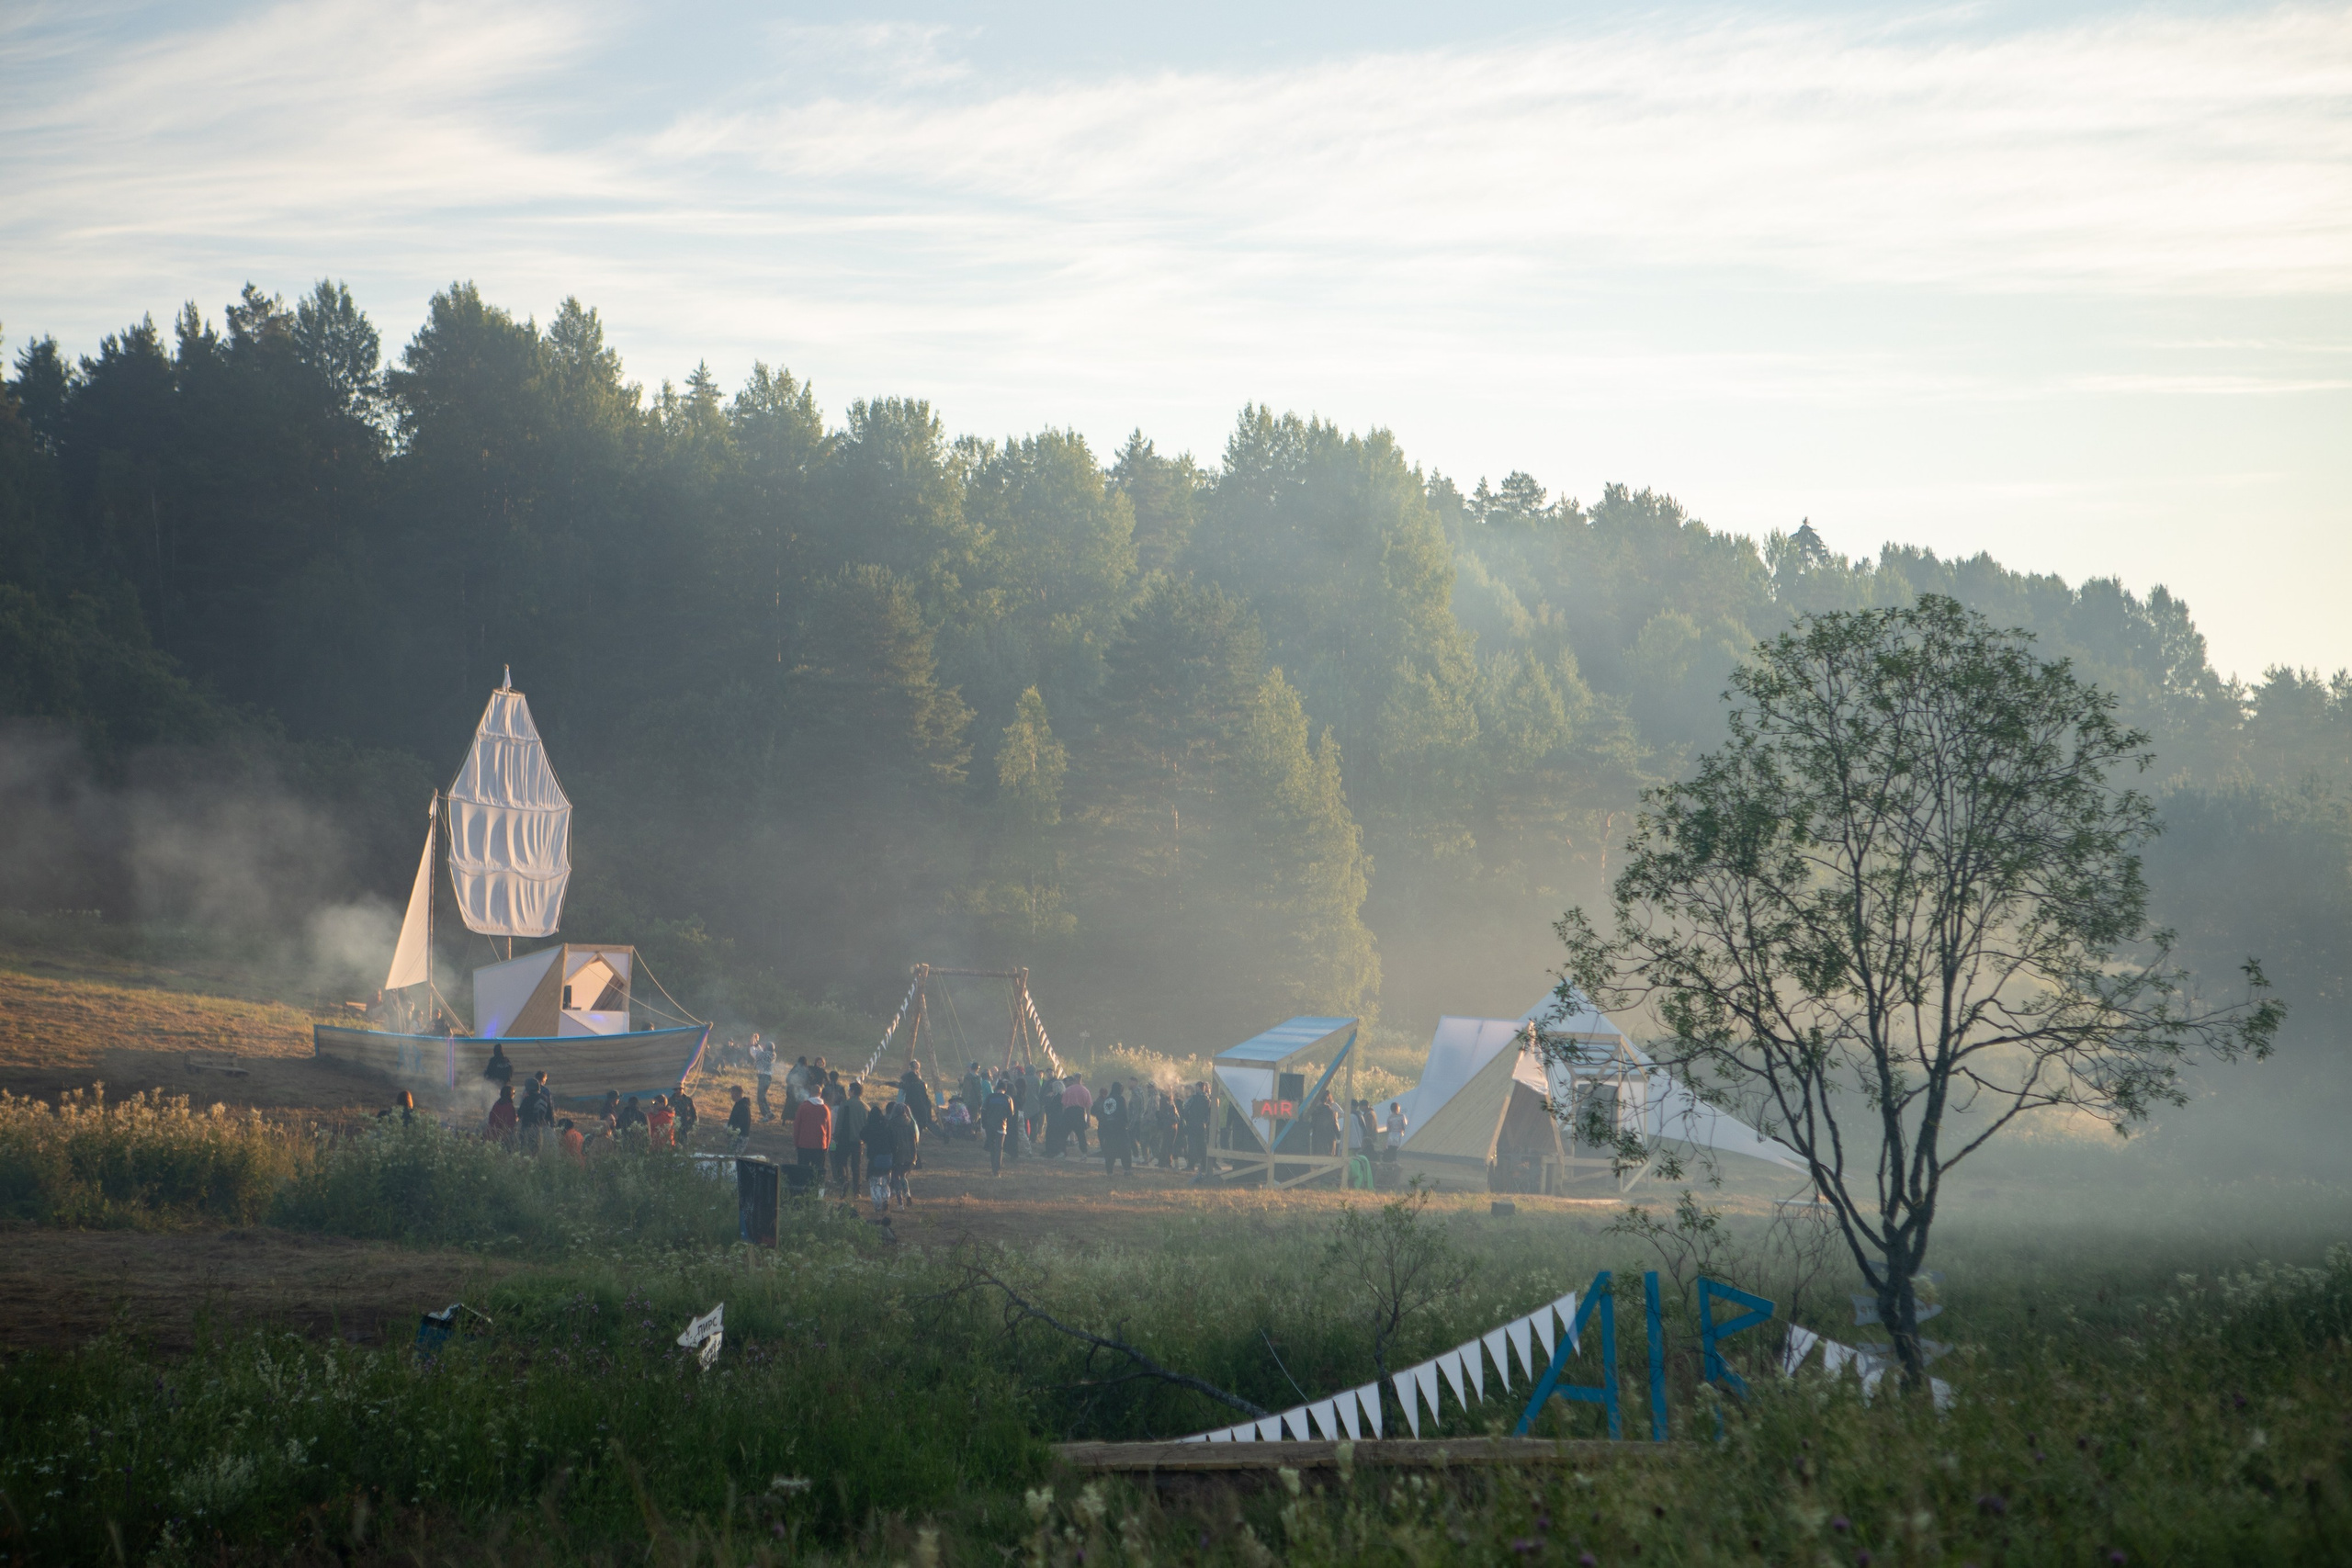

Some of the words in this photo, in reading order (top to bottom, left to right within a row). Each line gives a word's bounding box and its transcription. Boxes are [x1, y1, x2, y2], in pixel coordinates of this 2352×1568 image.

[1261, 1101, 1293, 1117] AIR
[697, 1316, 718, 1336] ПИРС
[1512, 1270, 1776, 1441] AIR
